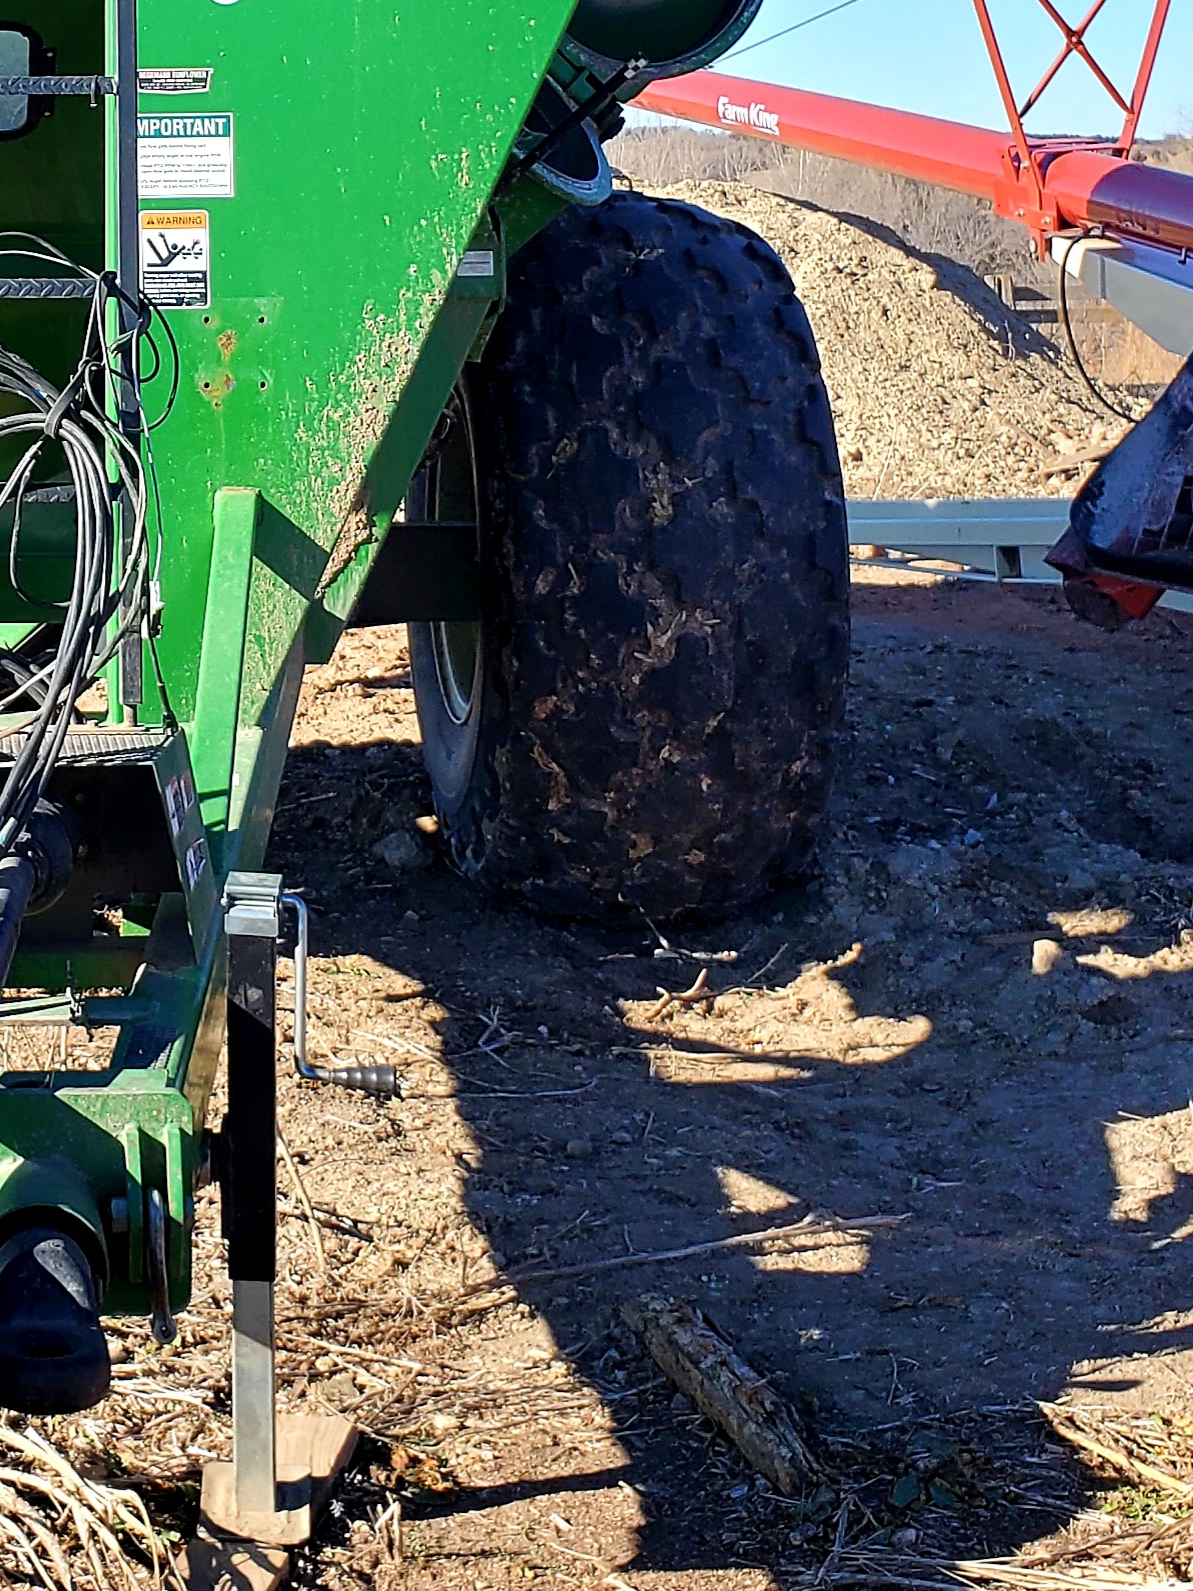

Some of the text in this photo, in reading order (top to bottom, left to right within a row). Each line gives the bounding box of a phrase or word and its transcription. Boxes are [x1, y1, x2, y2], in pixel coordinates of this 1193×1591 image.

[717, 96, 780, 134] Farm King
[137, 118, 227, 137] MPORTANT
[156, 216, 202, 225] WARNING
